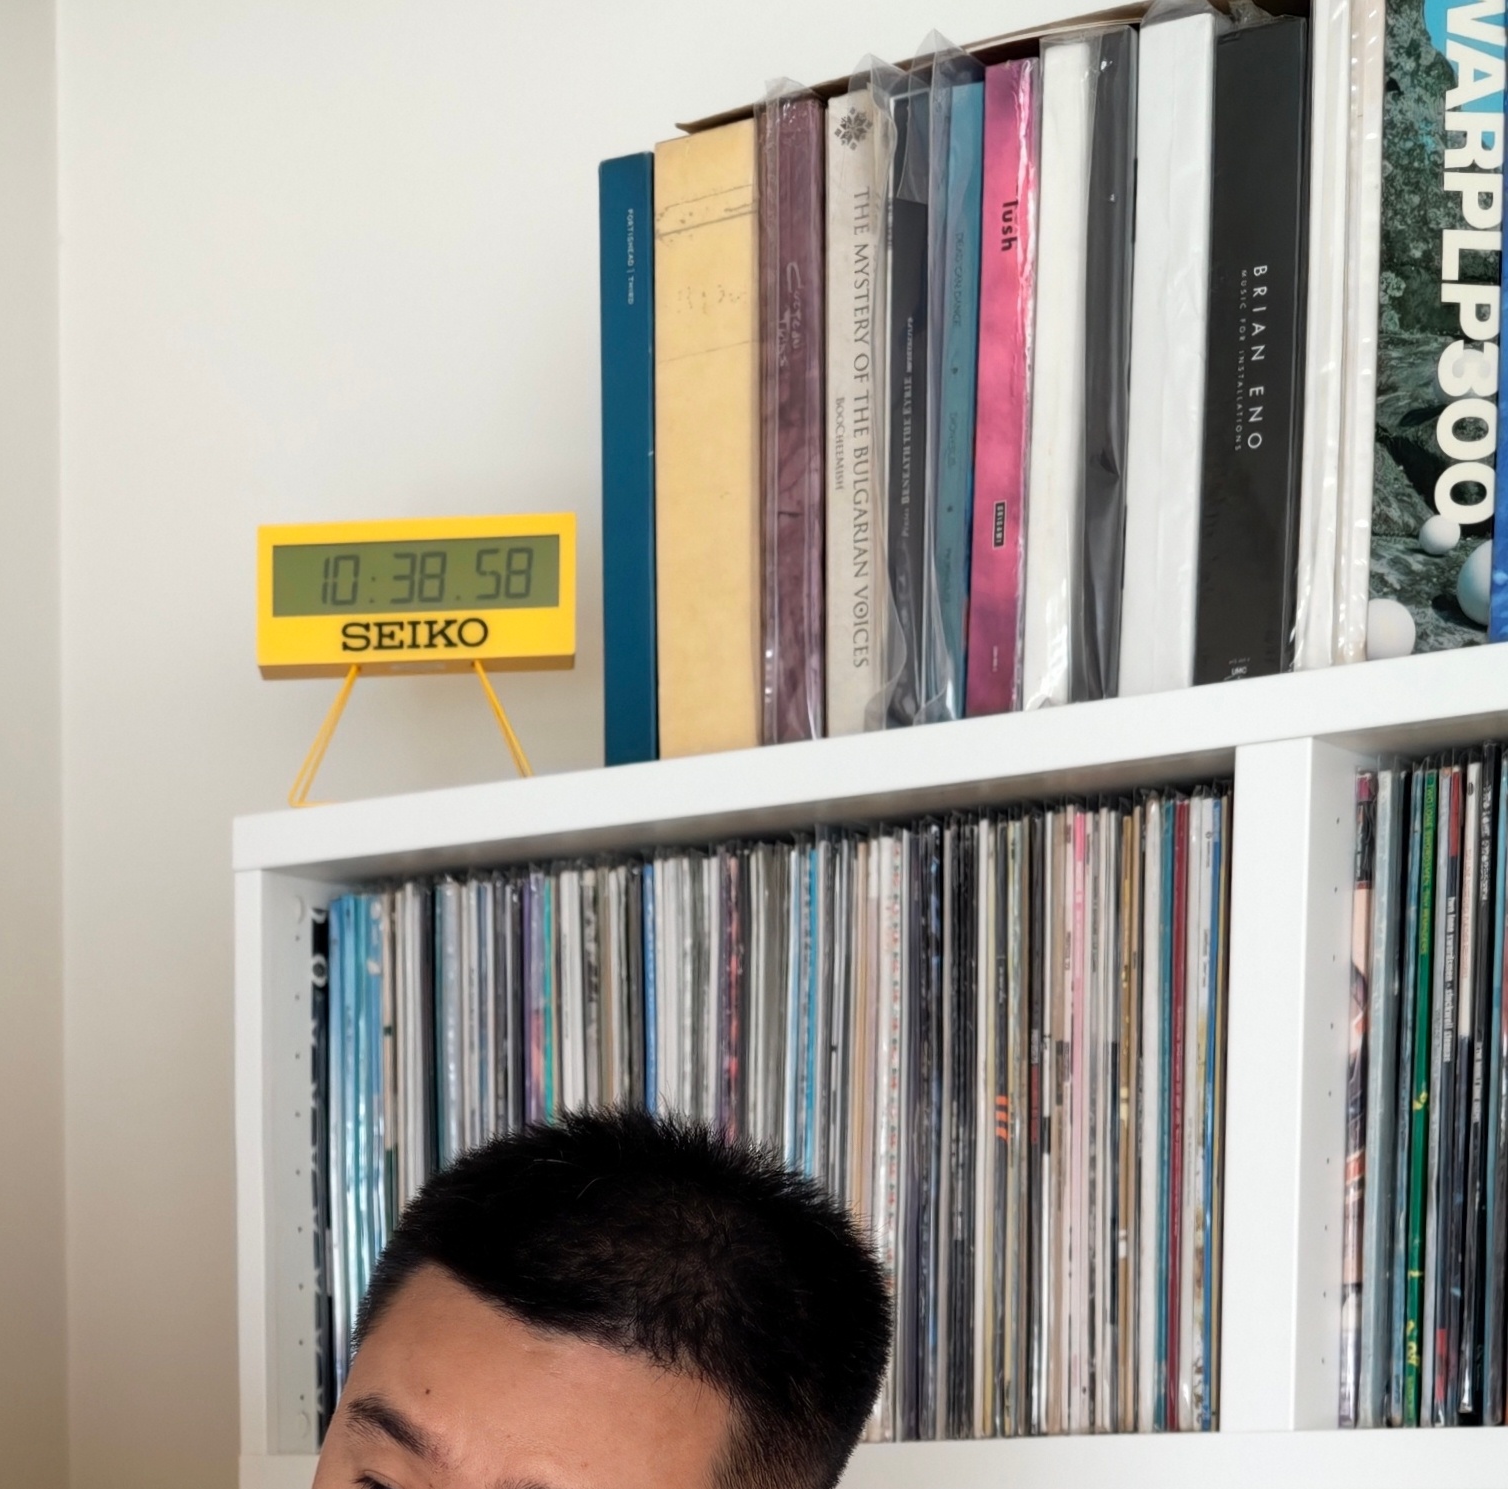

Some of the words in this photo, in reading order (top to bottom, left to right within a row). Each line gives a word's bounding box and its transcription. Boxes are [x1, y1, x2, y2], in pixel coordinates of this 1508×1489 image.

[626, 208, 634, 266] PORTISHEAD
[853, 186, 871, 236] THE
[1000, 200, 1019, 252] lush
[626, 275, 634, 305] THIRD
[853, 243, 870, 344] MYSTERY
[1239, 269, 1248, 310] MUSIC
[1250, 264, 1268, 362] BRIAN
[1238, 318, 1246, 342] FOR
[853, 352, 870, 384] OF
[853, 390, 870, 438] THE
[1234, 350, 1245, 451] INSTALLATIONS
[1247, 386, 1265, 450] ENO
[853, 446, 870, 578] BULGARIAN
[341, 617, 489, 652] SEIKO
[853, 585, 870, 669] VOICES
